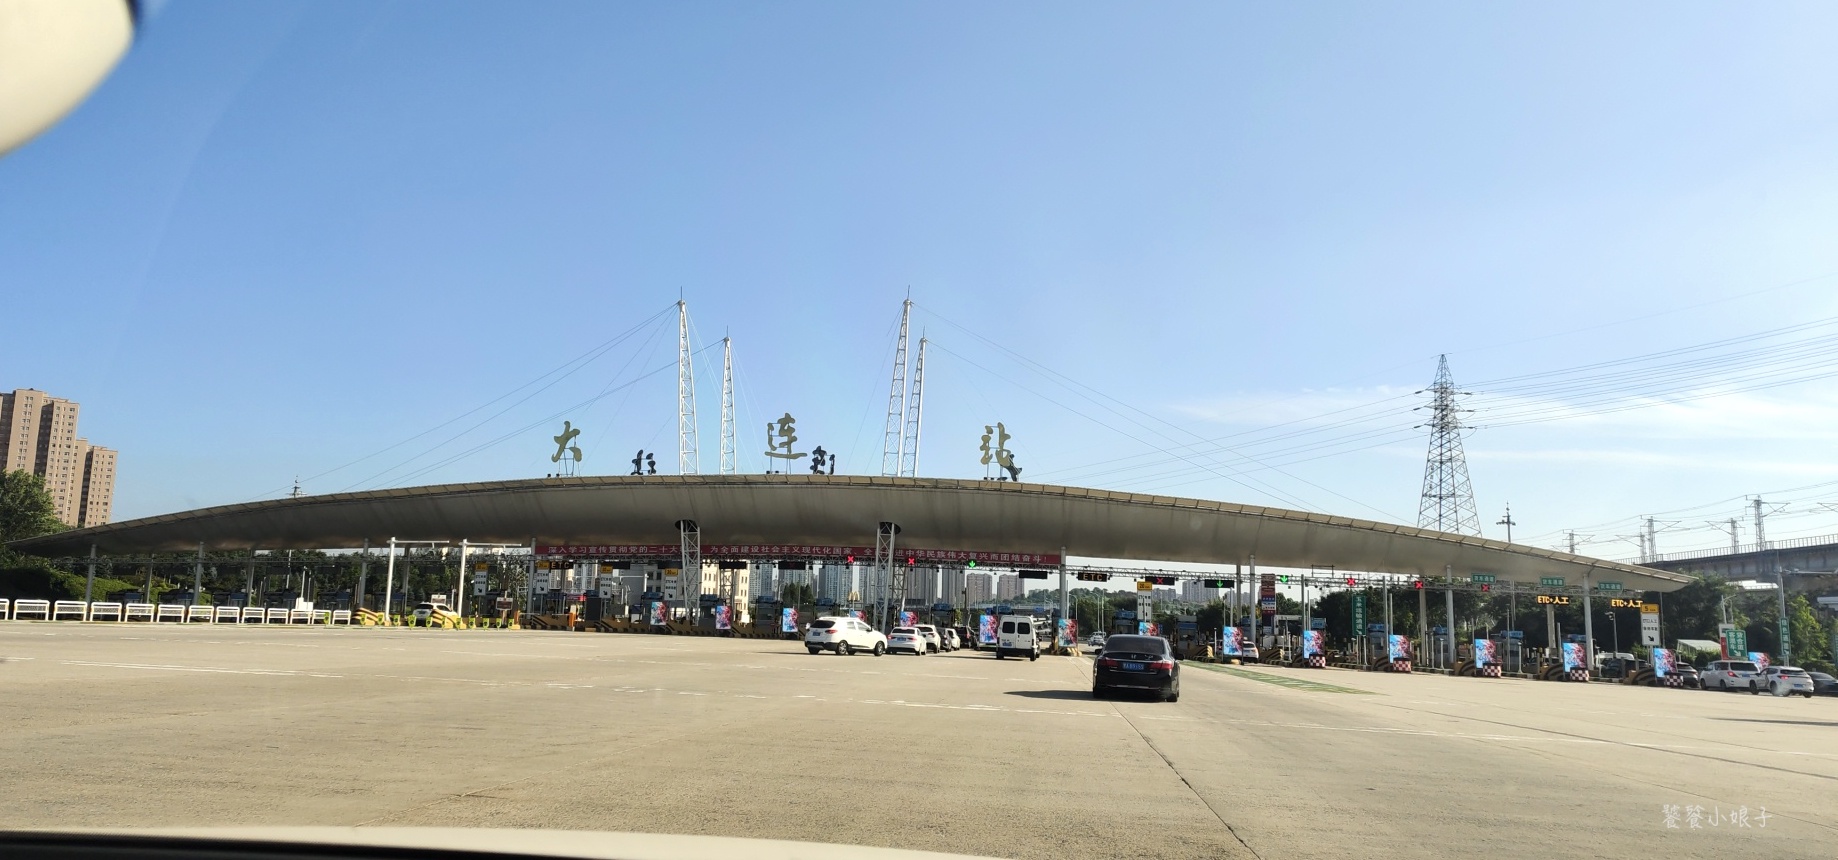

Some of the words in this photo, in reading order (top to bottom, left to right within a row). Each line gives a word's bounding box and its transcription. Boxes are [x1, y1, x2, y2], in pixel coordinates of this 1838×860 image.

[1083, 573, 1103, 581] ETC
[1537, 595, 1569, 604] ETC+人工
[1611, 599, 1643, 608] ETC+人工
